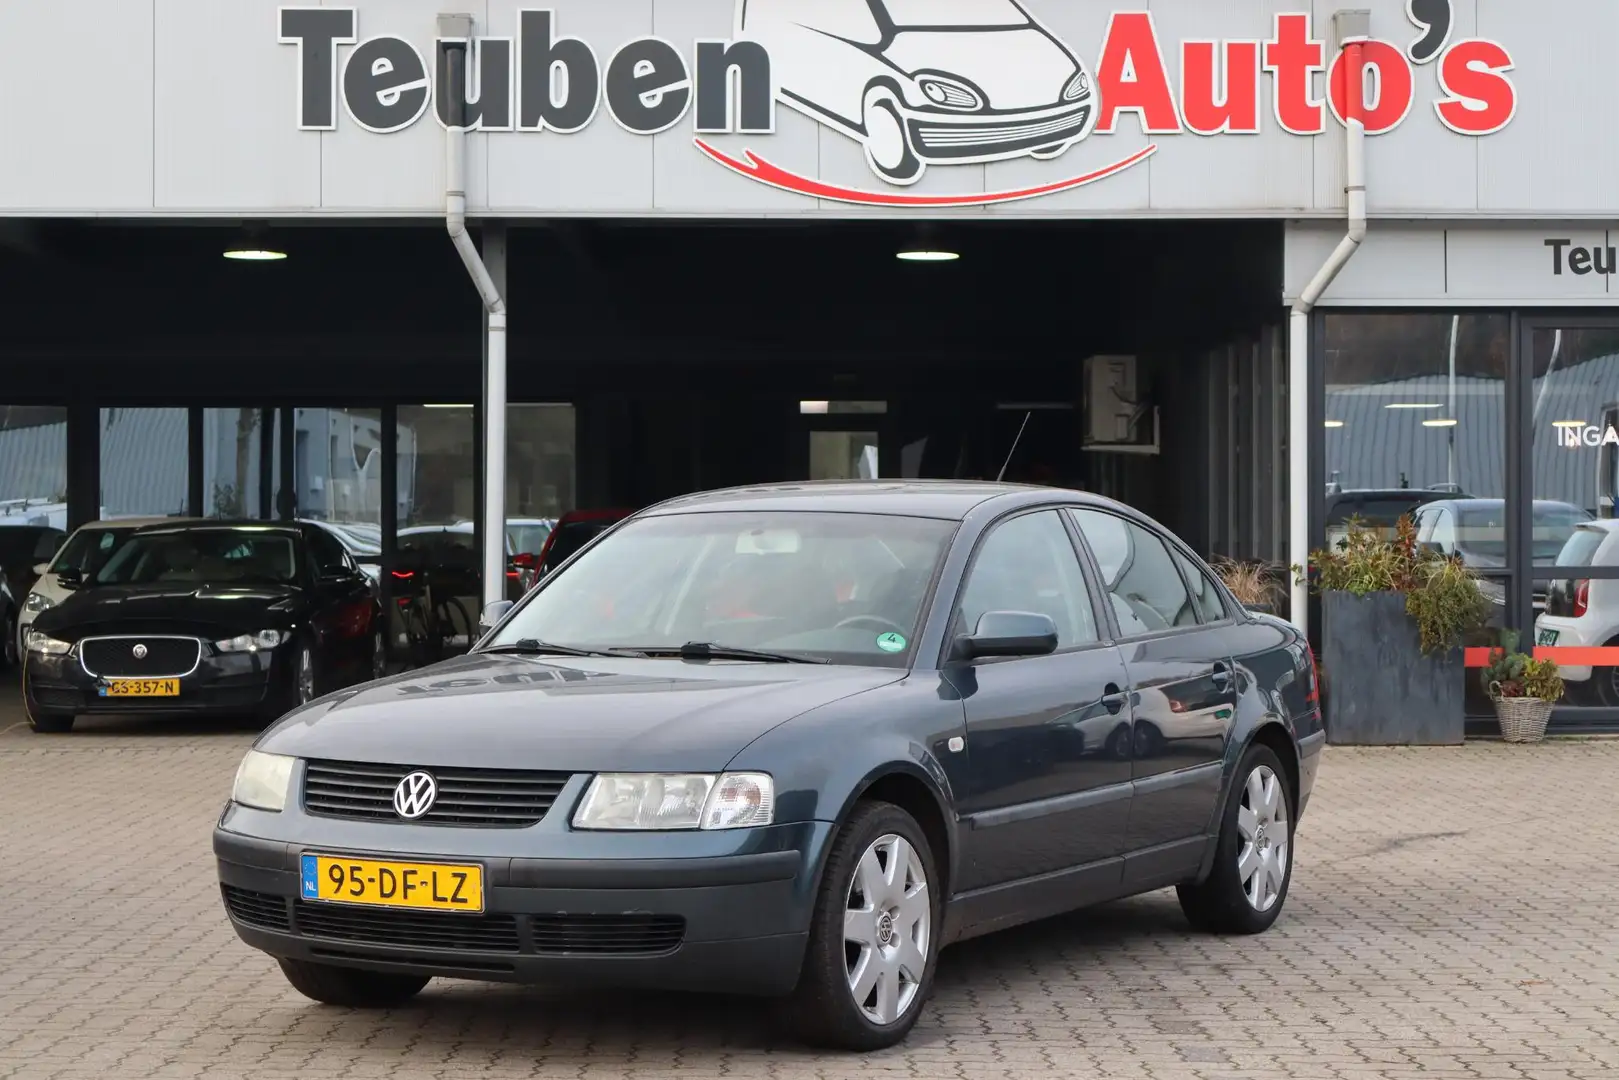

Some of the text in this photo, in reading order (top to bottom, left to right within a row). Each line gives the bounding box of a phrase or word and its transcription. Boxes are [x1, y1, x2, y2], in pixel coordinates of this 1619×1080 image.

[279, 0, 1517, 135] Teuben Auto's
[1544, 239, 1617, 275] Teu
[1557, 425, 1619, 447] INGA
[887, 633, 896, 643] 4
[305, 880, 317, 892] NL
[328, 863, 469, 904] 95-DF-LZ
